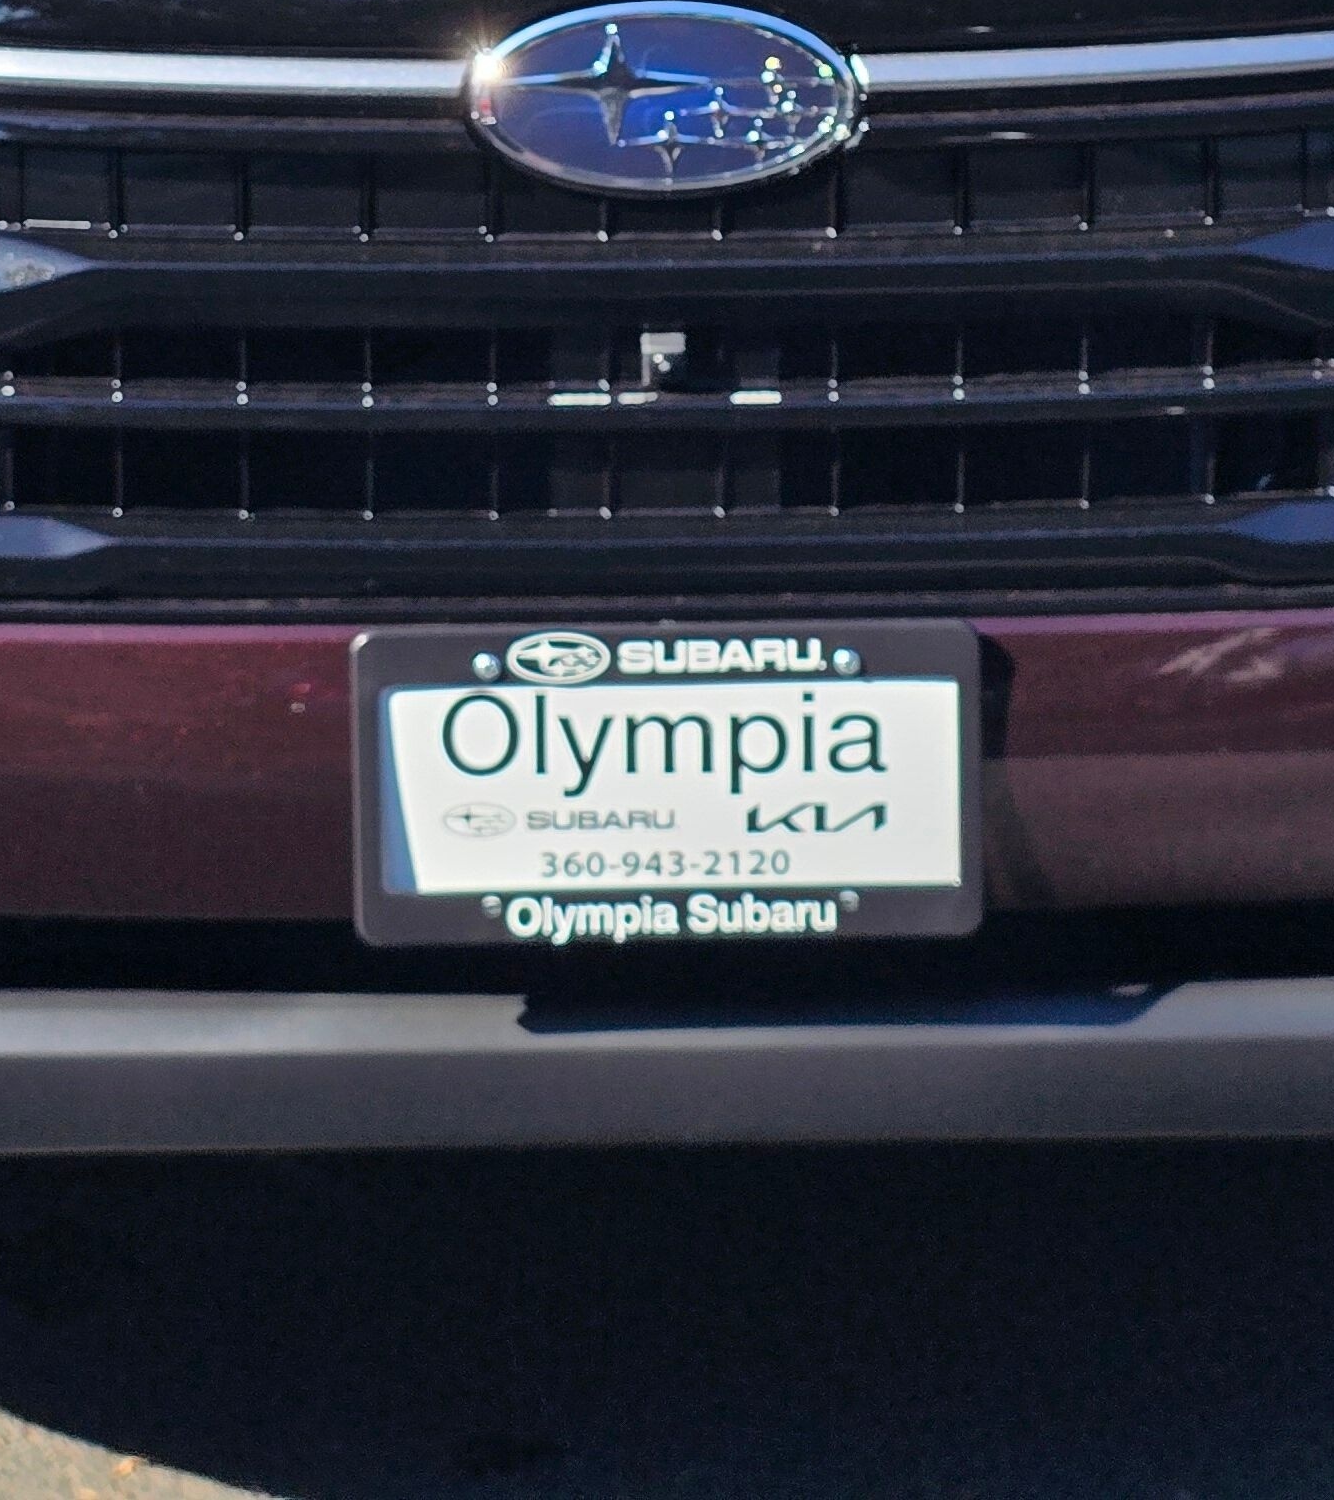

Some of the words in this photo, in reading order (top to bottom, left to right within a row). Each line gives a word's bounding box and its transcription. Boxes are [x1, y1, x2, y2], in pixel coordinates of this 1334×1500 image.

[616, 637, 824, 674] SUBARU
[442, 690, 888, 797] Olympia
[526, 809, 676, 832] SUBARU
[540, 849, 791, 878] 360-943-2120
[505, 893, 680, 947] Olympia
[686, 890, 839, 934] Subaru
